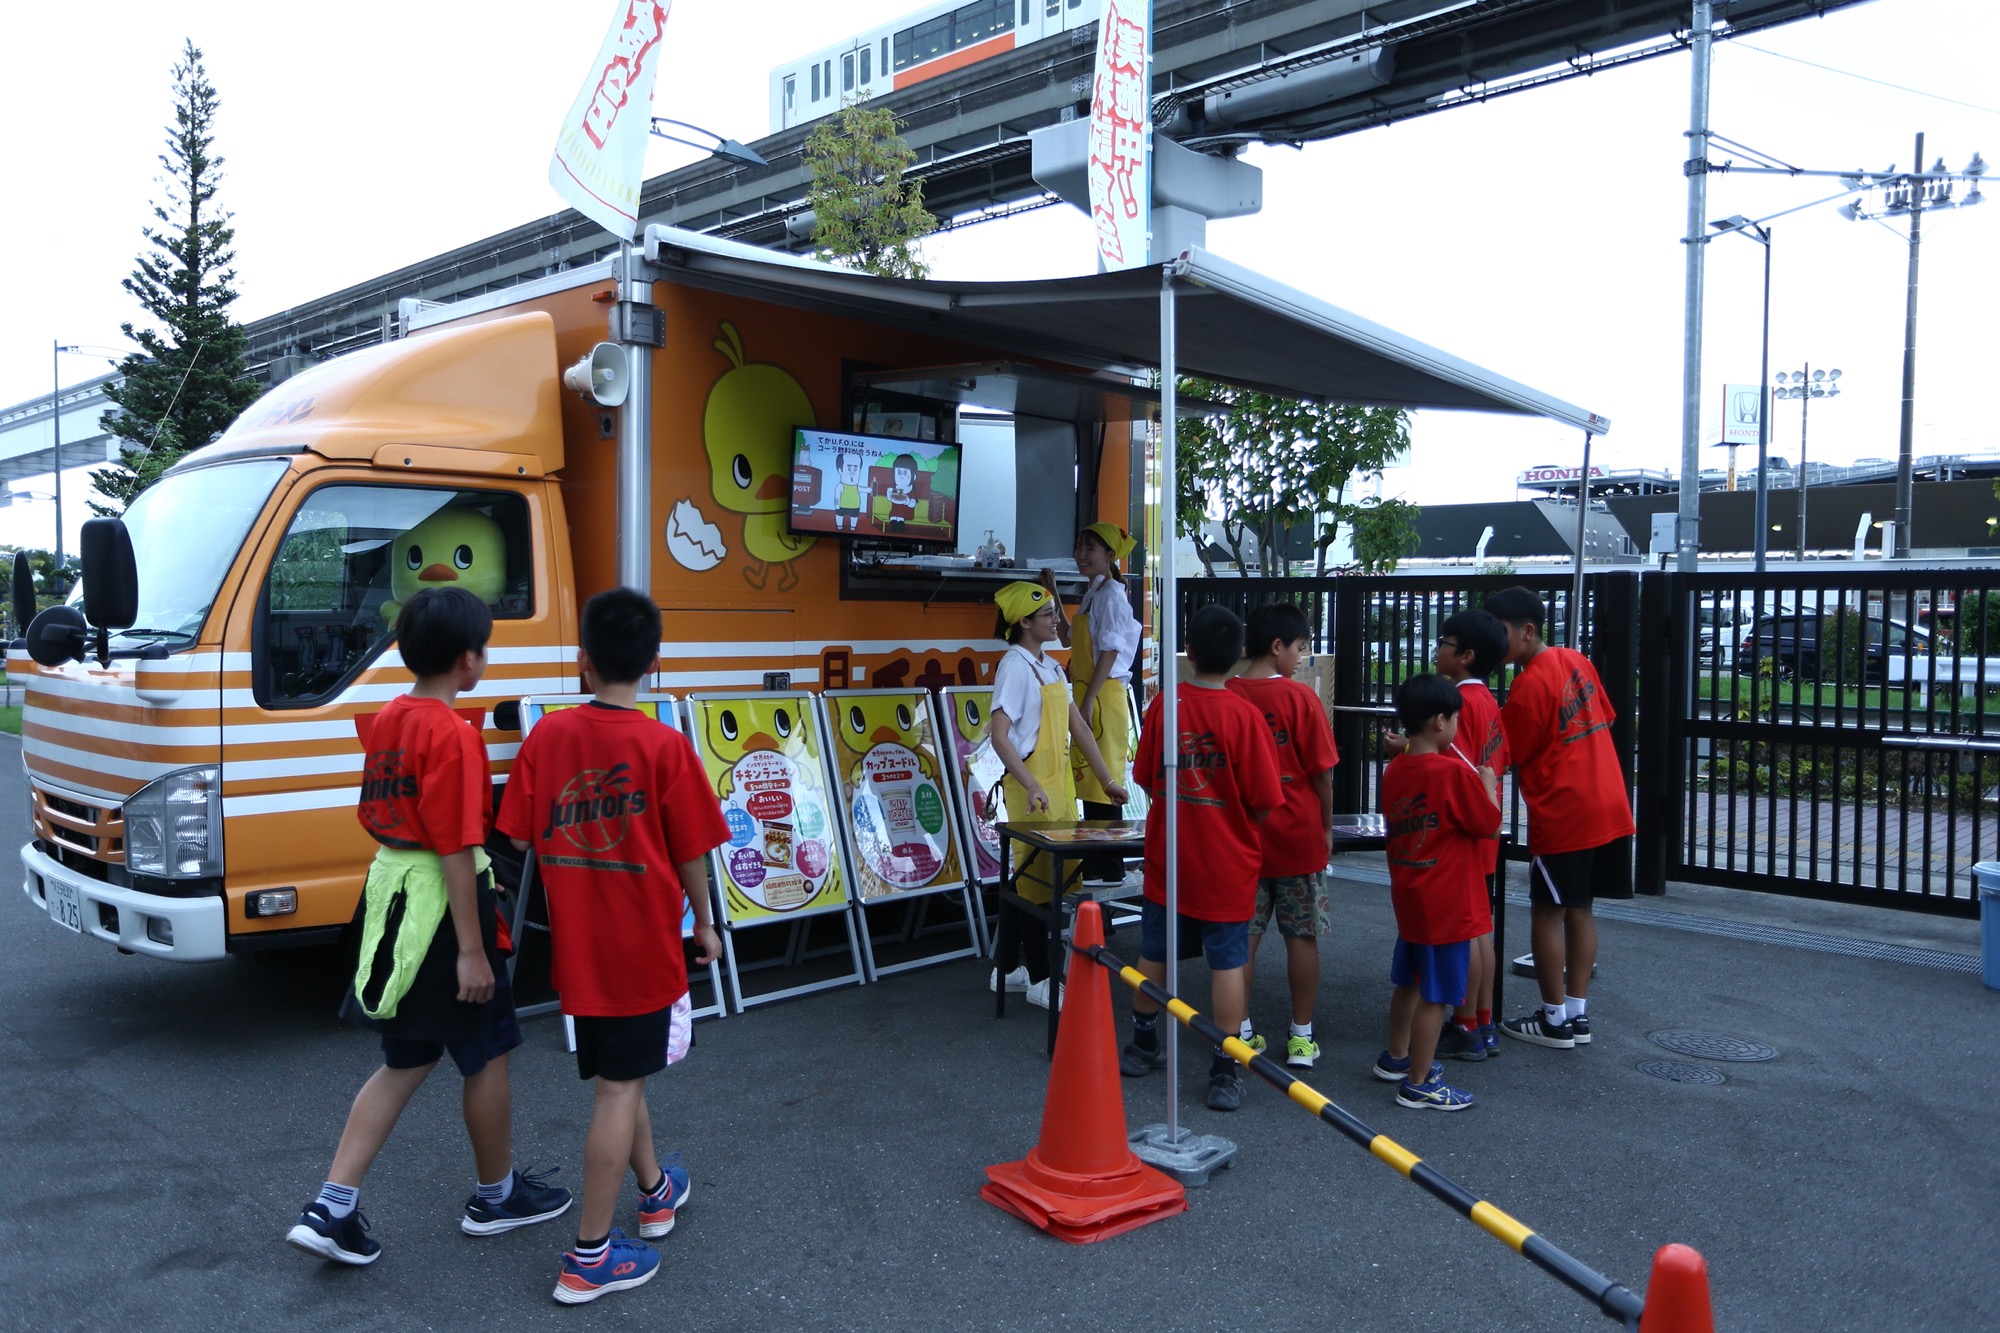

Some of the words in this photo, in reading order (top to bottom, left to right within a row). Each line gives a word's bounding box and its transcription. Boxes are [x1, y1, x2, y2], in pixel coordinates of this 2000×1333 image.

[1729, 429, 1760, 437] HOND
[866, 757, 916, 771] カップヌードル
[1157, 751, 1227, 779] Jniors
[735, 767, 797, 781] チキンラーメン
[758, 795, 782, 803] おいしい
[542, 790, 647, 840] Juniors
